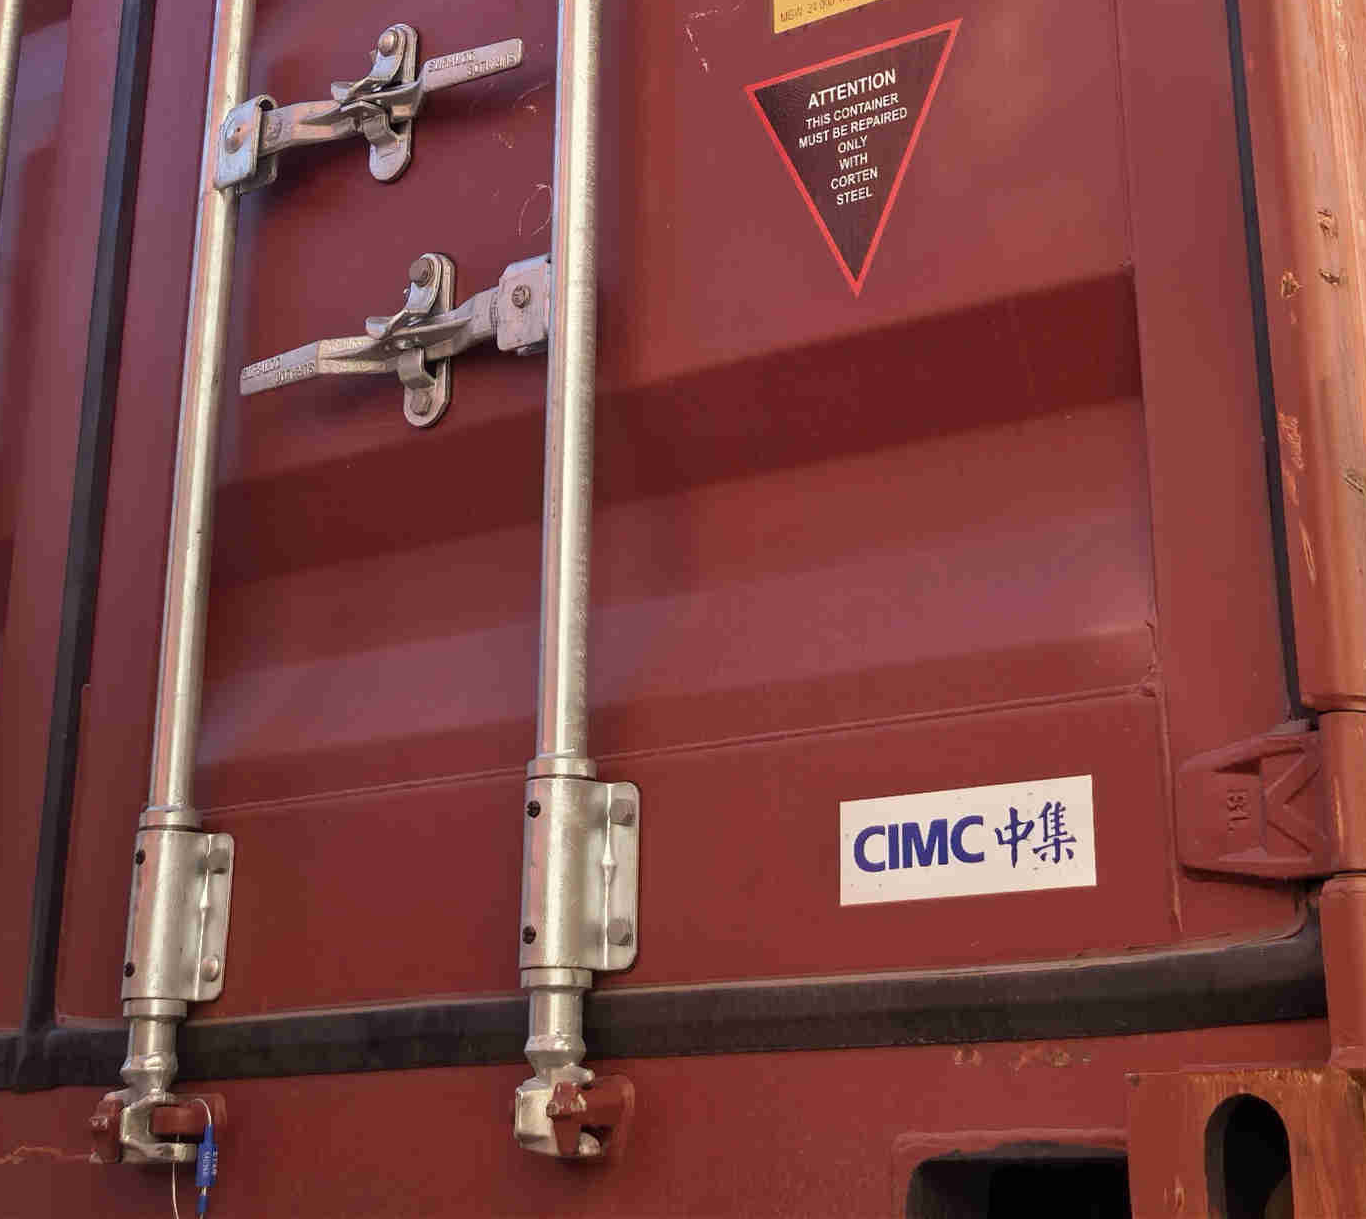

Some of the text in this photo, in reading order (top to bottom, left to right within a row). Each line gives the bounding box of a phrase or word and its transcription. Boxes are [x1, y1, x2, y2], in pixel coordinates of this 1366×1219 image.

[807, 68, 897, 109] ATTENTION
[805, 92, 899, 130] THIS CONTAINER
[798, 106, 908, 149] MUST BE REPAIRED
[837, 134, 868, 154] ONLY
[839, 151, 868, 171] WITH
[830, 166, 879, 190] CORTEN
[836, 187, 873, 206] STEEL
[853, 800, 1077, 873] CIMC 中集
